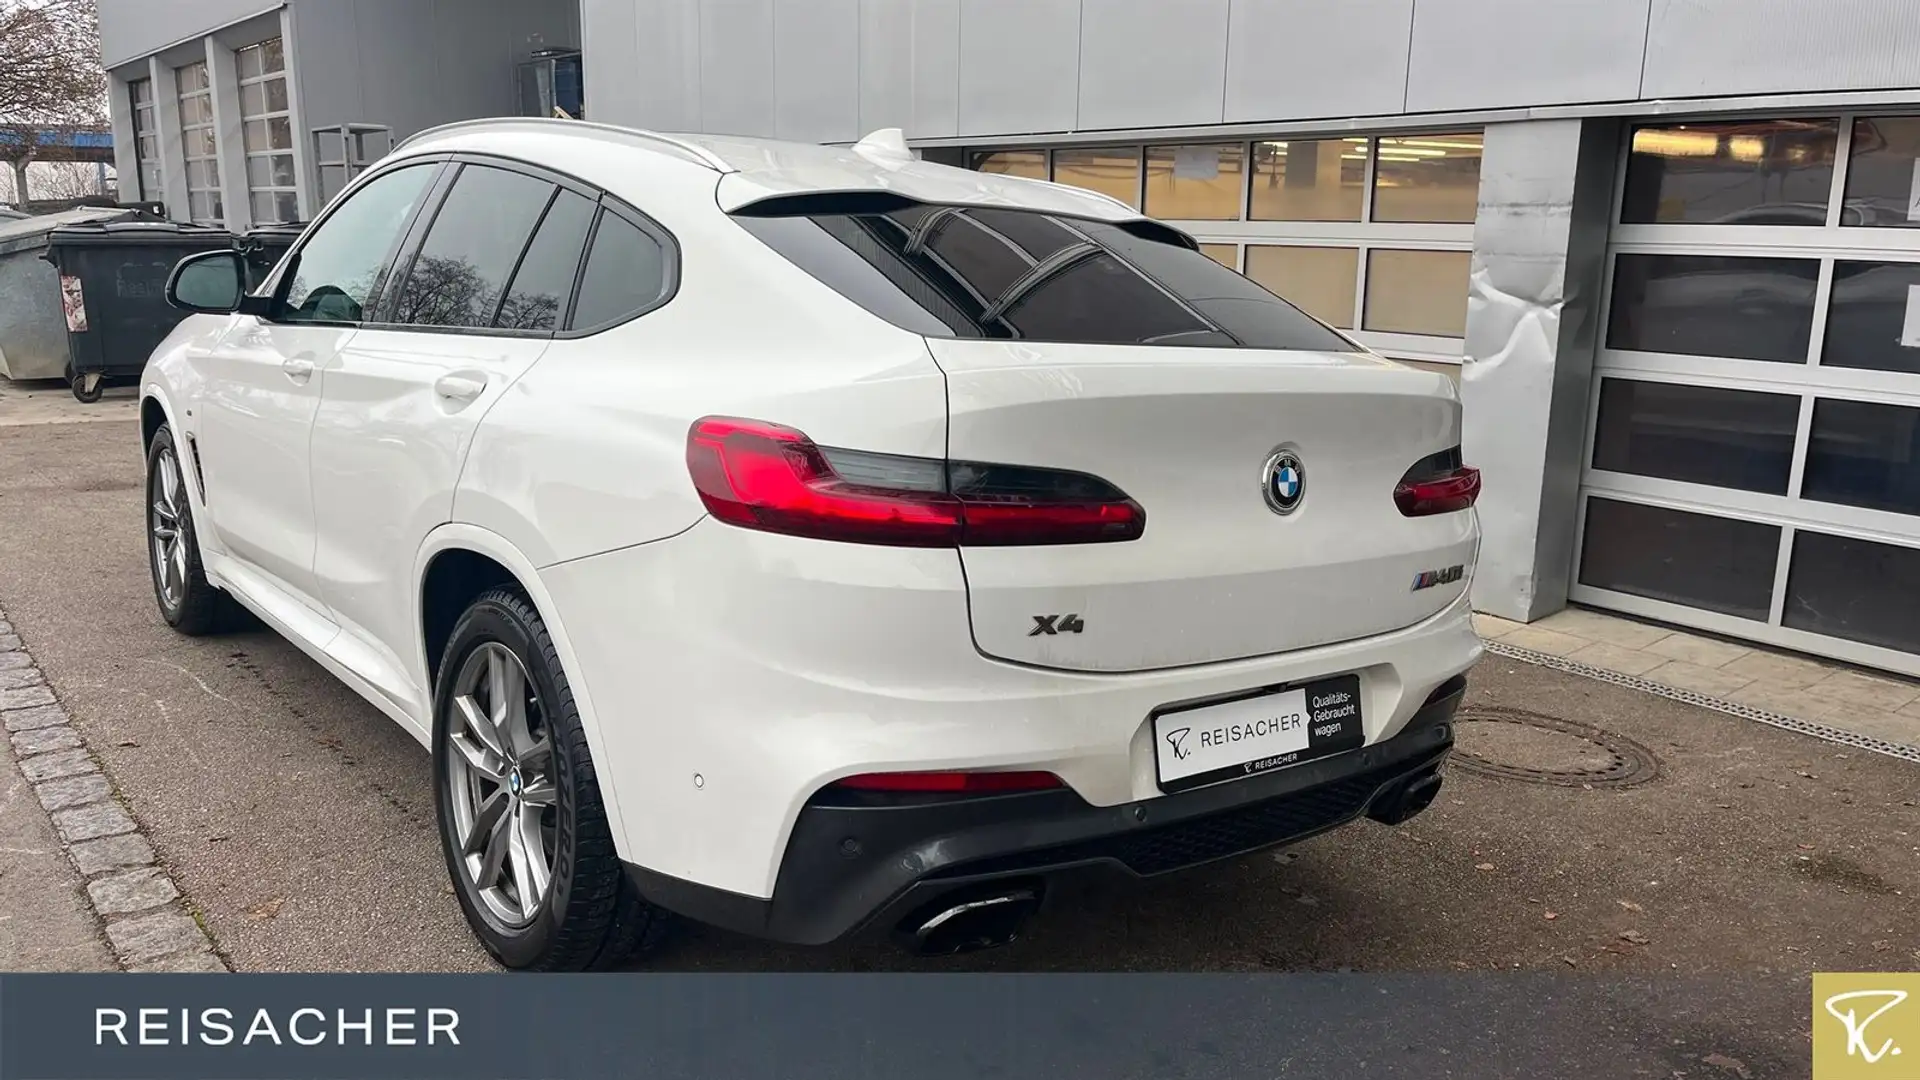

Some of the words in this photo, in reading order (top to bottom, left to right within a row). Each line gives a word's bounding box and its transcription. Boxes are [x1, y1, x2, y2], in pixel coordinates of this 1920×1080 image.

[1027, 613, 1085, 637] X4
[1312, 691, 1352, 708] Qualitäts-
[1313, 704, 1355, 722] Gebraucht
[1201, 713, 1301, 748] REISACHER
[1314, 722, 1342, 737] wagen
[1255, 753, 1298, 770] REISACHER
